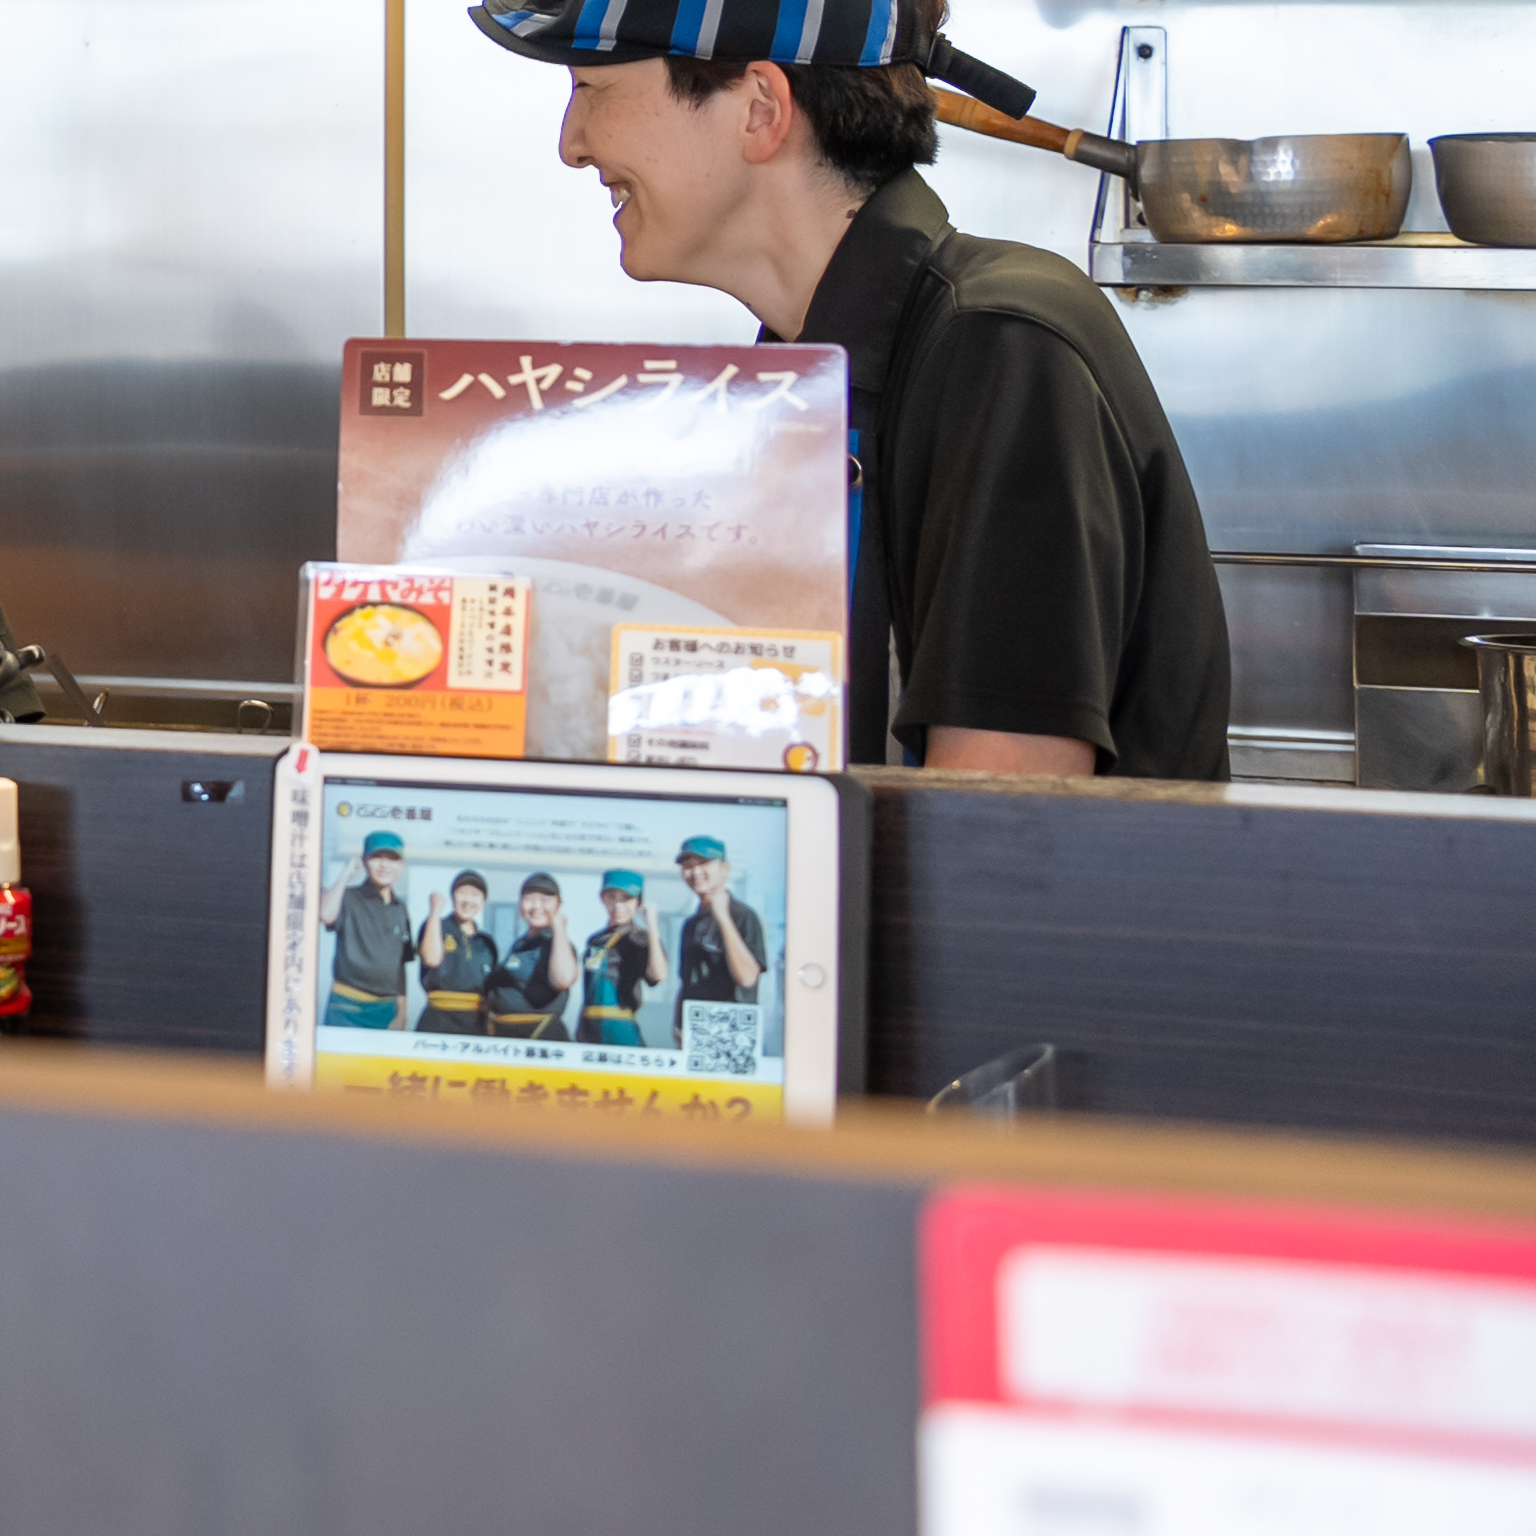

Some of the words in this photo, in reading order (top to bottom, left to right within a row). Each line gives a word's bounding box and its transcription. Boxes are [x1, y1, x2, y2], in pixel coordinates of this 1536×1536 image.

[372, 362, 412, 384] 店舗
[438, 355, 809, 412] ハヤシライス
[371, 387, 412, 409] 限定
[455, 515, 759, 545] わい深いハヤシライスです。
[652, 638, 796, 658] お客様へのお知らせ
